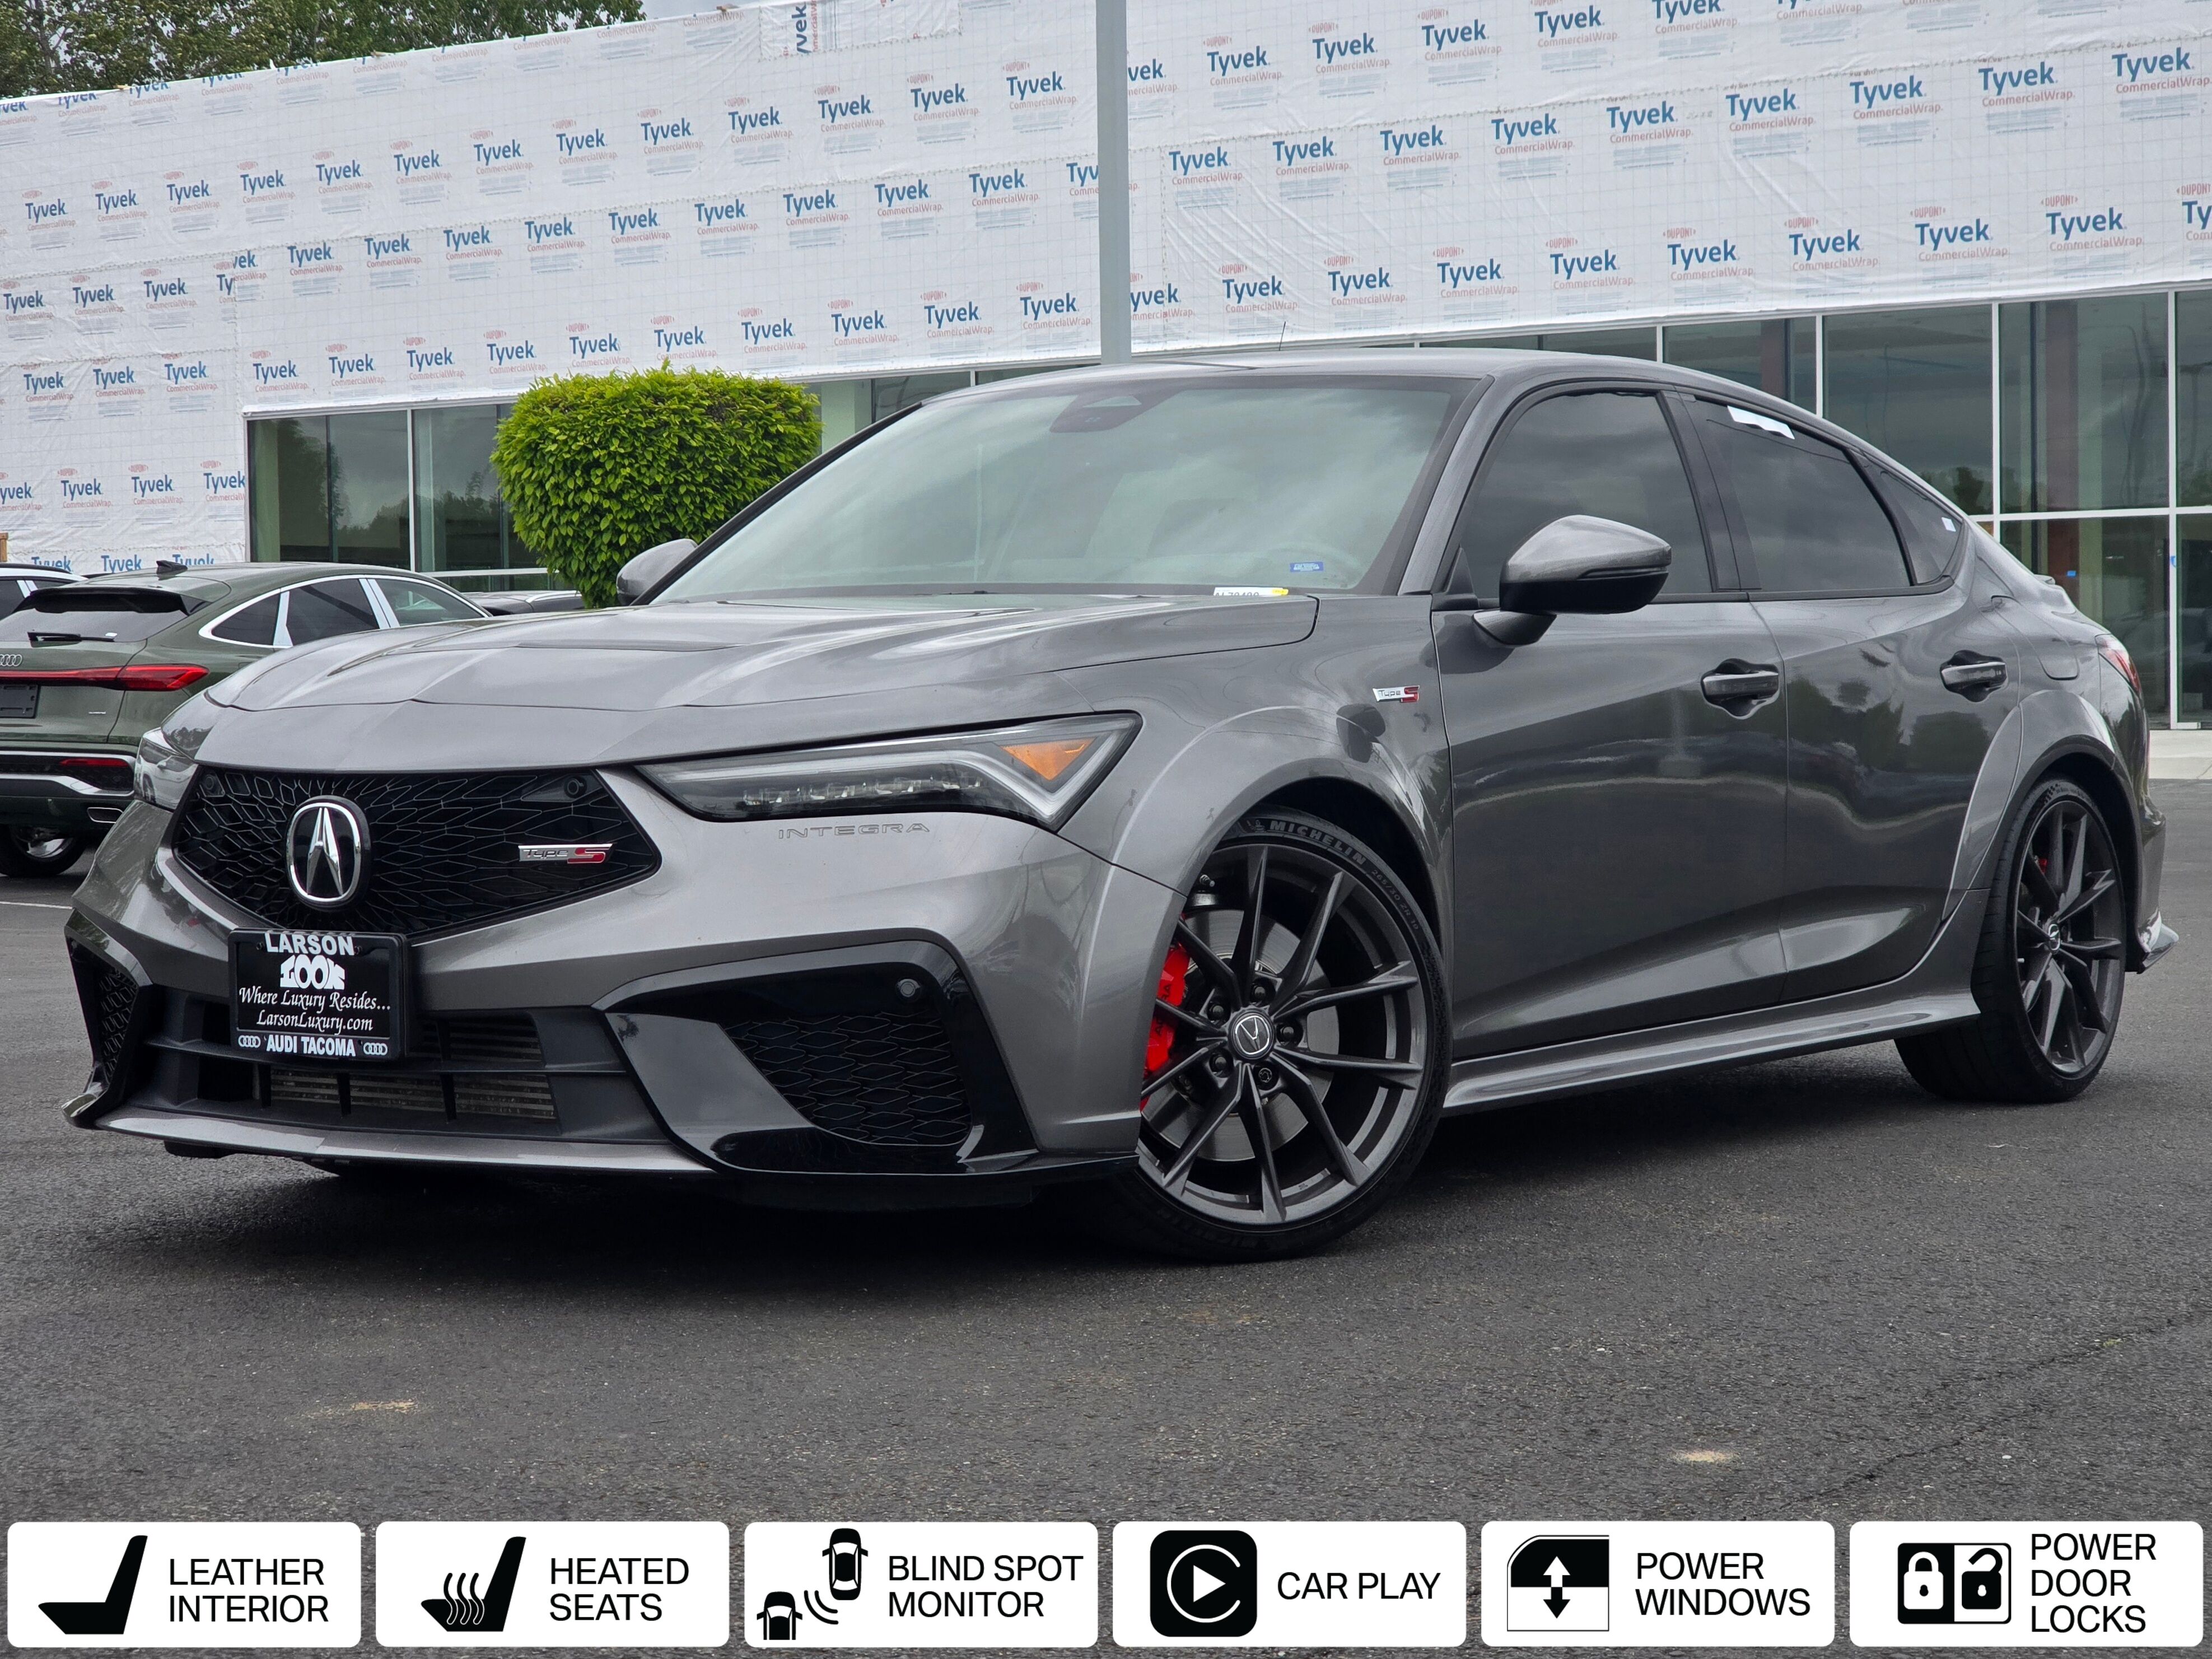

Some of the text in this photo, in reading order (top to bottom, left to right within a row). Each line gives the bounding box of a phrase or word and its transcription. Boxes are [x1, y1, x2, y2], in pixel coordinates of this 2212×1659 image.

[1534, 5, 1602, 39] Tyvek
[1776, 2, 1863, 21] CommercialWrap
[1421, 18, 1486, 52] Tyvek
[1655, 17, 1738, 34] CommercialWrap
[1312, 33, 1375, 65] Tyvek
[1538, 32, 1618, 49] CommercialWrap
[1206, 46, 1270, 77] Tyvek
[1426, 46, 1502, 62] CommercialWrap
[2111, 47, 2191, 83] Tyvek
[1126, 58, 1164, 82] vek
[1316, 59, 1391, 75] CommercialWrap
[1978, 61, 2055, 97] Tyvek
[1006, 71, 1063, 101] Tyvek
[1210, 72, 1285, 87] CommercialWrap
[2117, 75, 2211, 93] CommercialWrap
[911, 83, 966, 113] Tyvek
[1009, 96, 1077, 111] CommercialWrap
[1849, 74, 1923, 110] Tyvek
[1984, 90, 2074, 107] CommercialWrap
[818, 95, 871, 124] Tyvek
[1725, 87, 1796, 122] Tyvek
[1855, 102, 1942, 120] CommercialWrap
[728, 107, 781, 135] Tyvek
[822, 119, 884, 133] CommercialWrap
[1606, 100, 1675, 134] Tyvek
[1730, 115, 1814, 132] CommercialWrap
[640, 117, 694, 145] Tyvek
[1379, 125, 1444, 157] Tyvek
[1491, 113, 1557, 146] Tyvek
[1611, 128, 1692, 145] CommercialWrap
[474, 139, 522, 166] Tyvek
[556, 128, 608, 157] Tyvek
[1272, 136, 1334, 167] Tyvek
[1495, 140, 1574, 156] CommercialWrap
[394, 151, 440, 176] Tyvek
[1168, 146, 1229, 176] Tyvek
[1276, 162, 1350, 178] CommercialWrap
[1384, 151, 1459, 167] CommercialWrap
[241, 171, 284, 195] Tyvek
[316, 161, 361, 185] Tyvek
[968, 169, 1025, 198] Tyvek
[1066, 162, 1099, 188] Tyv
[1172, 171, 1243, 186] CommercialWrap
[166, 181, 210, 204] Tyvek
[874, 179, 929, 208] Tyvek
[972, 193, 1039, 208] CommercialWrap
[2181, 183, 2211, 195] DUPONT
[26, 199, 67, 222] Tyvek
[96, 192, 138, 214] Tyvek
[694, 198, 746, 227] Tyvek
[782, 189, 836, 218] Tyvek
[878, 204, 942, 218] CommercialWrap
[525, 217, 573, 244] Tyvek
[609, 208, 658, 236] Tyvek
[2045, 207, 2123, 241] Tyvek
[364, 234, 410, 260] Tyvek
[444, 226, 491, 252] Tyvek
[1788, 229, 1860, 262] Tyvek
[1915, 218, 1990, 252] Tyvek
[2051, 234, 2142, 251] CommercialWrap
[234, 250, 256, 269] vek
[287, 244, 332, 268] Tyvek
[1550, 249, 1617, 281] Tyvek
[1667, 239, 1737, 272] Tyvek
[1793, 255, 1878, 272] CommercialWrap
[1920, 245, 2008, 262] CommercialWrap
[1327, 268, 1390, 298] Tyvek
[1436, 259, 1502, 290] Tyvek
[1554, 275, 1634, 291] CommercialWrap
[1672, 265, 1754, 282] CommercialWrap
[73, 285, 114, 307] Tyvek
[144, 280, 186, 301] Tyvek
[1130, 282, 1180, 313] yvek
[1222, 277, 1283, 305] Tyvek
[1331, 292, 1406, 308] CommercialWrap
[1441, 283, 1518, 300] CommercialWrap
[4, 292, 44, 314] Tyvek
[1019, 292, 1077, 322] Tyvek
[1131, 308, 1194, 321] mmercialWrap
[1226, 300, 1298, 315] CommercialWrap
[832, 311, 887, 338] Tyvek
[923, 301, 981, 330] Tyvek
[1023, 317, 1091, 332] CommercialWrap
[654, 327, 704, 353] Tyvek
[741, 319, 795, 346] Tyvek
[927, 325, 995, 340] CommercialWrap
[487, 341, 535, 366] Tyvek
[570, 333, 619, 360] Tyvek
[253, 361, 297, 385] Tyvek
[329, 354, 375, 378] Tyvek
[406, 349, 454, 373] Tyvek
[24, 372, 64, 395] Tyvek
[93, 367, 135, 389] Tyvek
[164, 361, 207, 386] Tyvek
[0, 482, 32, 502] yvek
[62, 478, 101, 500] Tyvek
[133, 474, 173, 497] Tyvek
[205, 471, 246, 493] Tyvek
[1378, 685, 1420, 703] Type S
[778, 823, 930, 839] INTEGRA
[1270, 819, 1366, 865] MICHELIN
[523, 845, 612, 864] Type S
[265, 931, 354, 956] LARSON
[239, 986, 391, 1013] Where Luxury Resides...
[256, 1009, 374, 1036] LarsonLuxury.com
[267, 1034, 356, 1056] AUDI TACOMA
